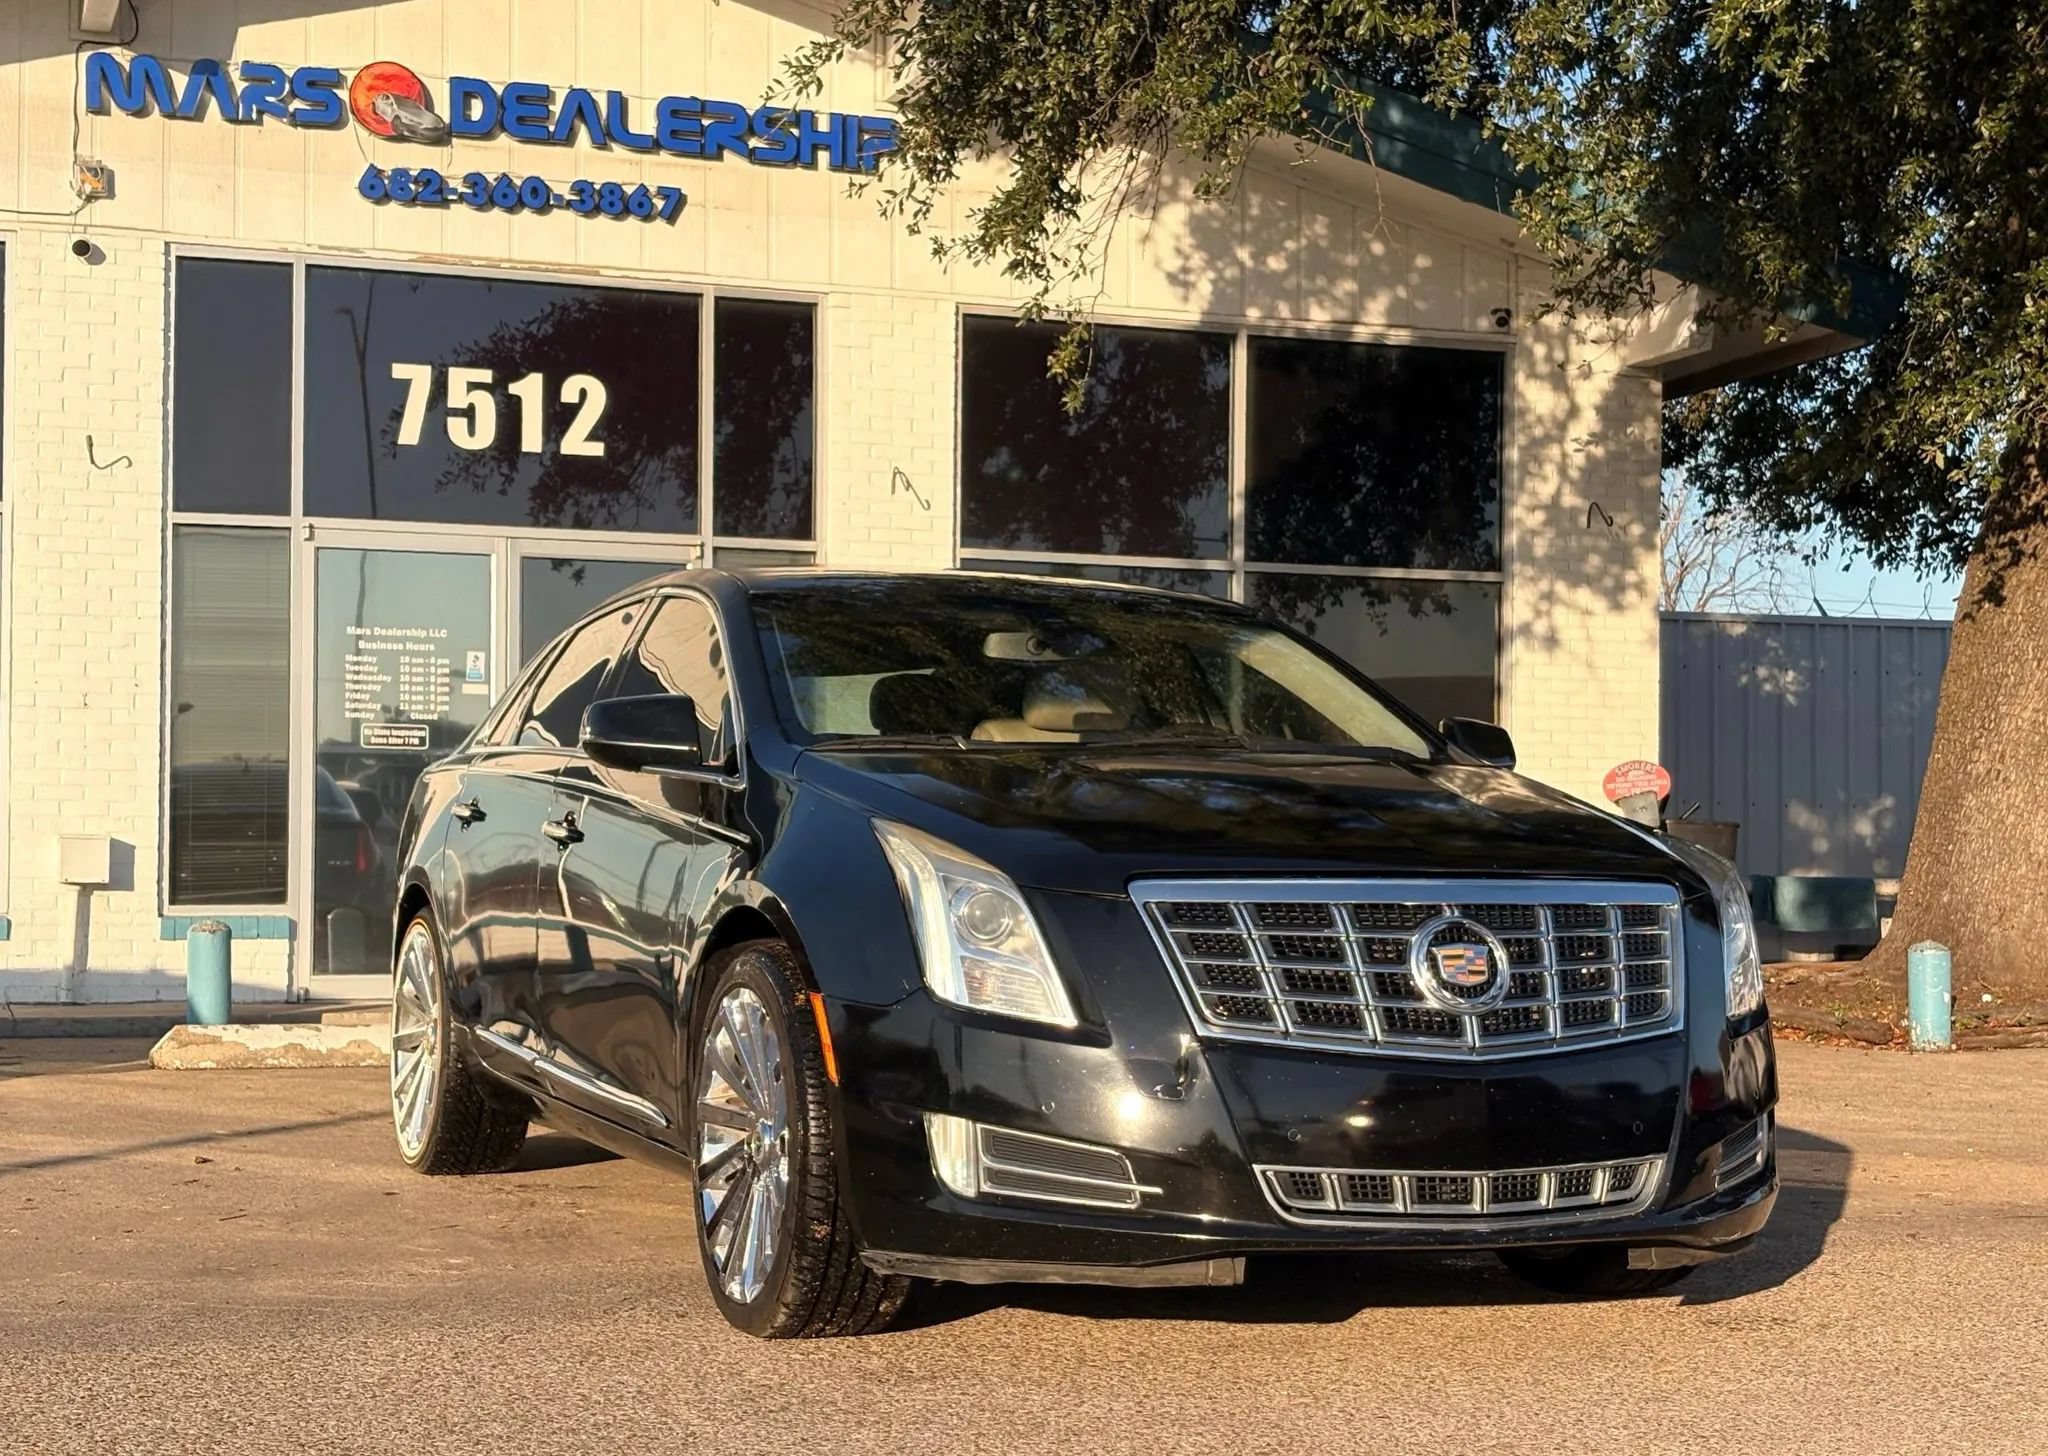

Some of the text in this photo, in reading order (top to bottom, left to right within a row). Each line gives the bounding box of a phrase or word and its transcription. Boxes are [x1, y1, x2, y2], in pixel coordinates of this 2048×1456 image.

[86, 51, 902, 174] MARS DEALERSHIP
[358, 163, 684, 222] 682-360-3867
[391, 362, 607, 457] 7512
[346, 626, 448, 639] Mars Dealership LLC
[358, 640, 435, 651] Business Hours
[345, 655, 378, 664] Monday
[400, 656, 410, 664] 10
[345, 664, 378, 673] Tuesday
[400, 664, 410, 672] 10
[345, 673, 392, 683] Wednesday
[400, 674, 410, 682] 10
[345, 682, 382, 692] Thursday
[400, 684, 410, 692] 10
[345, 692, 370, 701] Friday
[400, 693, 410, 701] 10
[345, 702, 382, 711] Saturday
[345, 711, 438, 720] Sunday Closed
